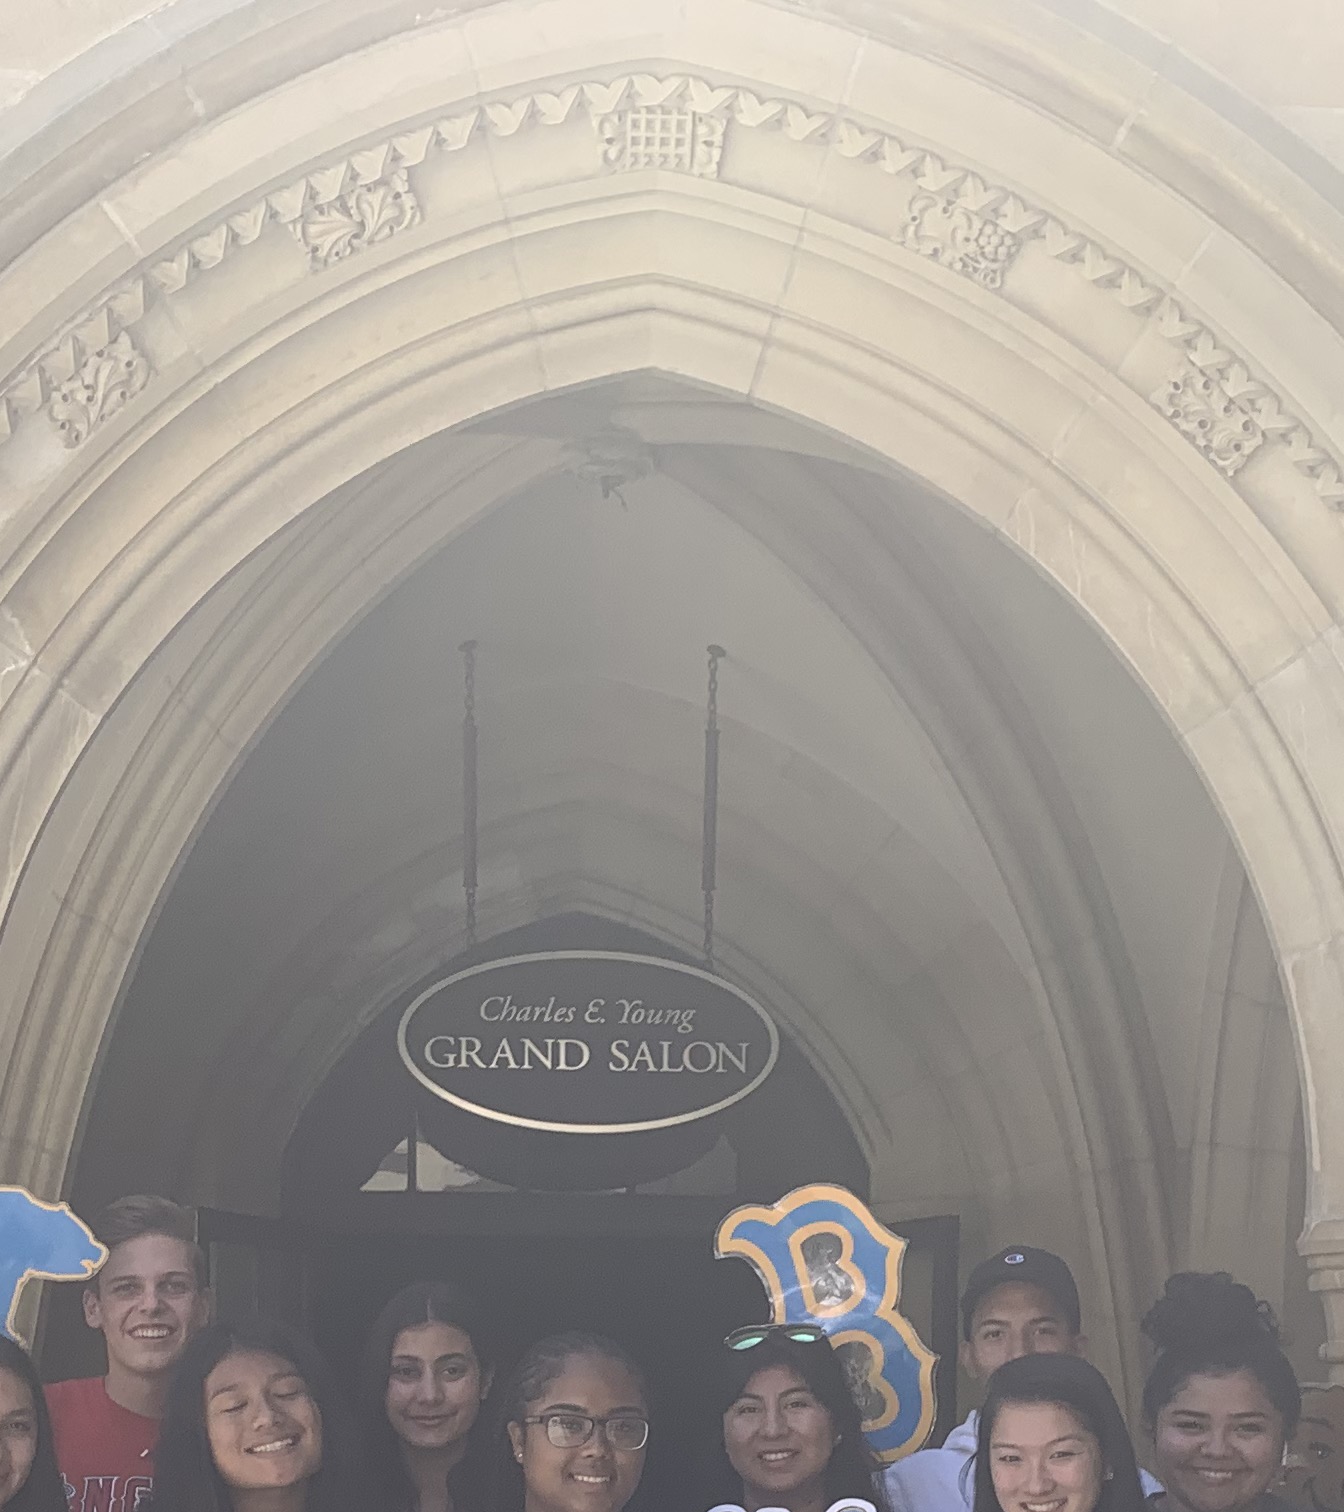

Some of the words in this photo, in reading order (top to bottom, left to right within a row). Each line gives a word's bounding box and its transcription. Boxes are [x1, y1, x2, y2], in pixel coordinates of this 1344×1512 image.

[479, 995, 577, 1025] Charles
[584, 998, 606, 1024] E.
[617, 999, 696, 1034] Young
[423, 1035, 591, 1072] GRAND
[608, 1040, 750, 1074] SALON
